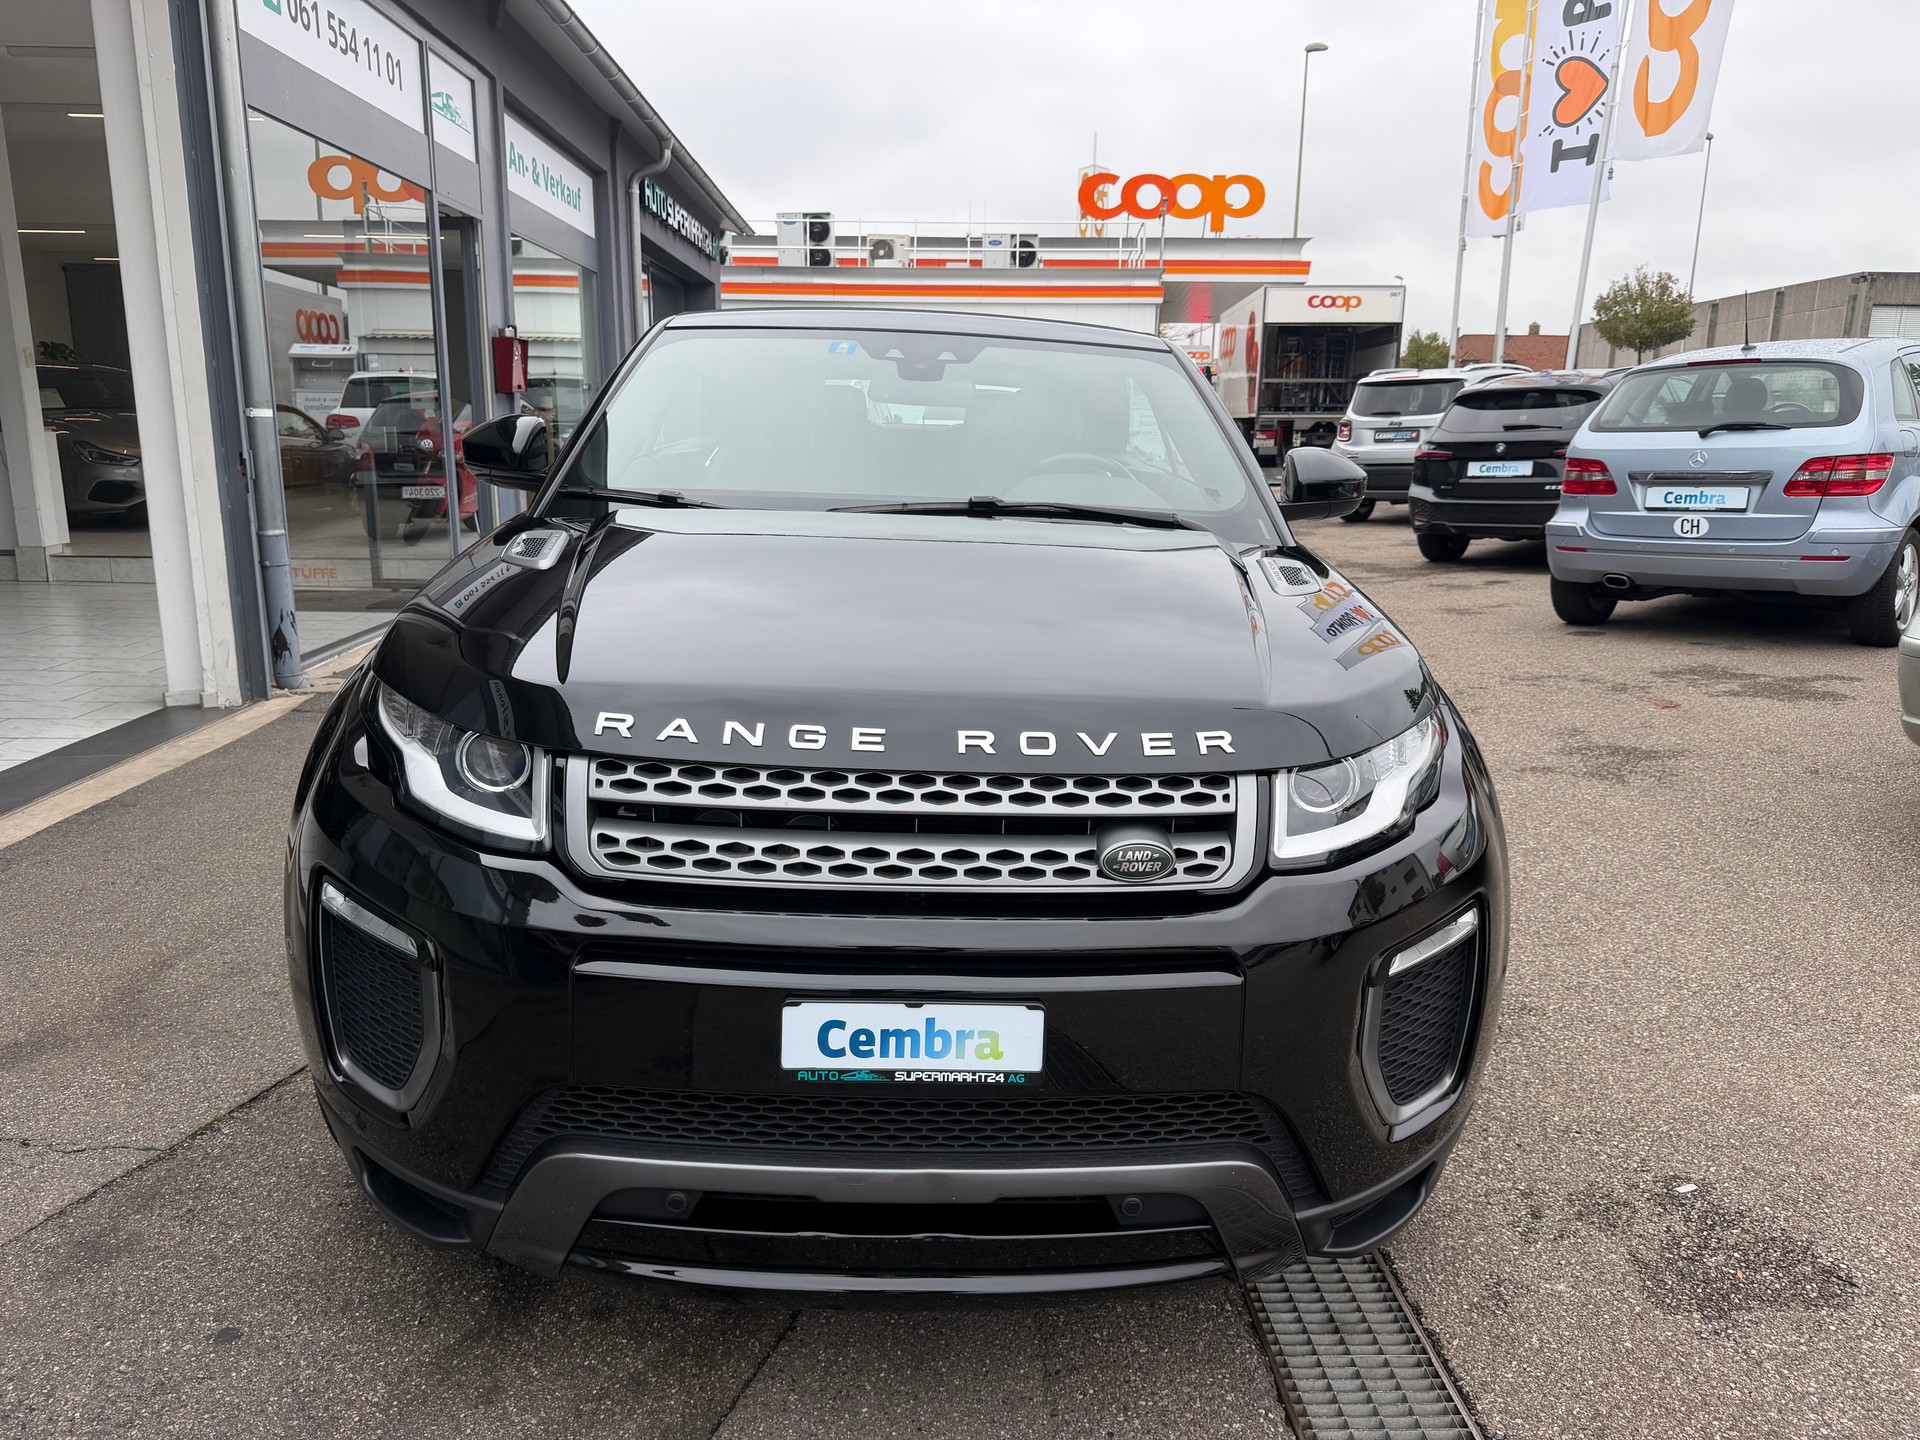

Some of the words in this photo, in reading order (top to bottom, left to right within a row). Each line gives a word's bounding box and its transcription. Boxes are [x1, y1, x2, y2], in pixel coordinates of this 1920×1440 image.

[287, 0, 320, 39] 061
[327, 9, 359, 63] 554
[363, 37, 381, 78] 11
[386, 51, 403, 91] 01
[509, 141, 529, 178] An-
[531, 157, 541, 188] &
[542, 163, 581, 213] Verkauf
[645, 176, 667, 221] AUTO
[1078, 173, 1265, 232] coop
[1307, 295, 1362, 312] coop
[1479, 463, 1519, 473] Cembra
[1664, 491, 1727, 505] Cembra
[1680, 518, 1700, 534] CH
[595, 712, 886, 752] RANGE
[957, 730, 1236, 755] ROVER
[1117, 851, 1152, 861] LAND
[1120, 861, 1162, 872] ROVER
[817, 1017, 1004, 1060] Cembra
[798, 1071, 839, 1081] AUTO
[894, 1071, 1005, 1083] SUPERMARKT24
[1008, 1073, 1025, 1084] AG
